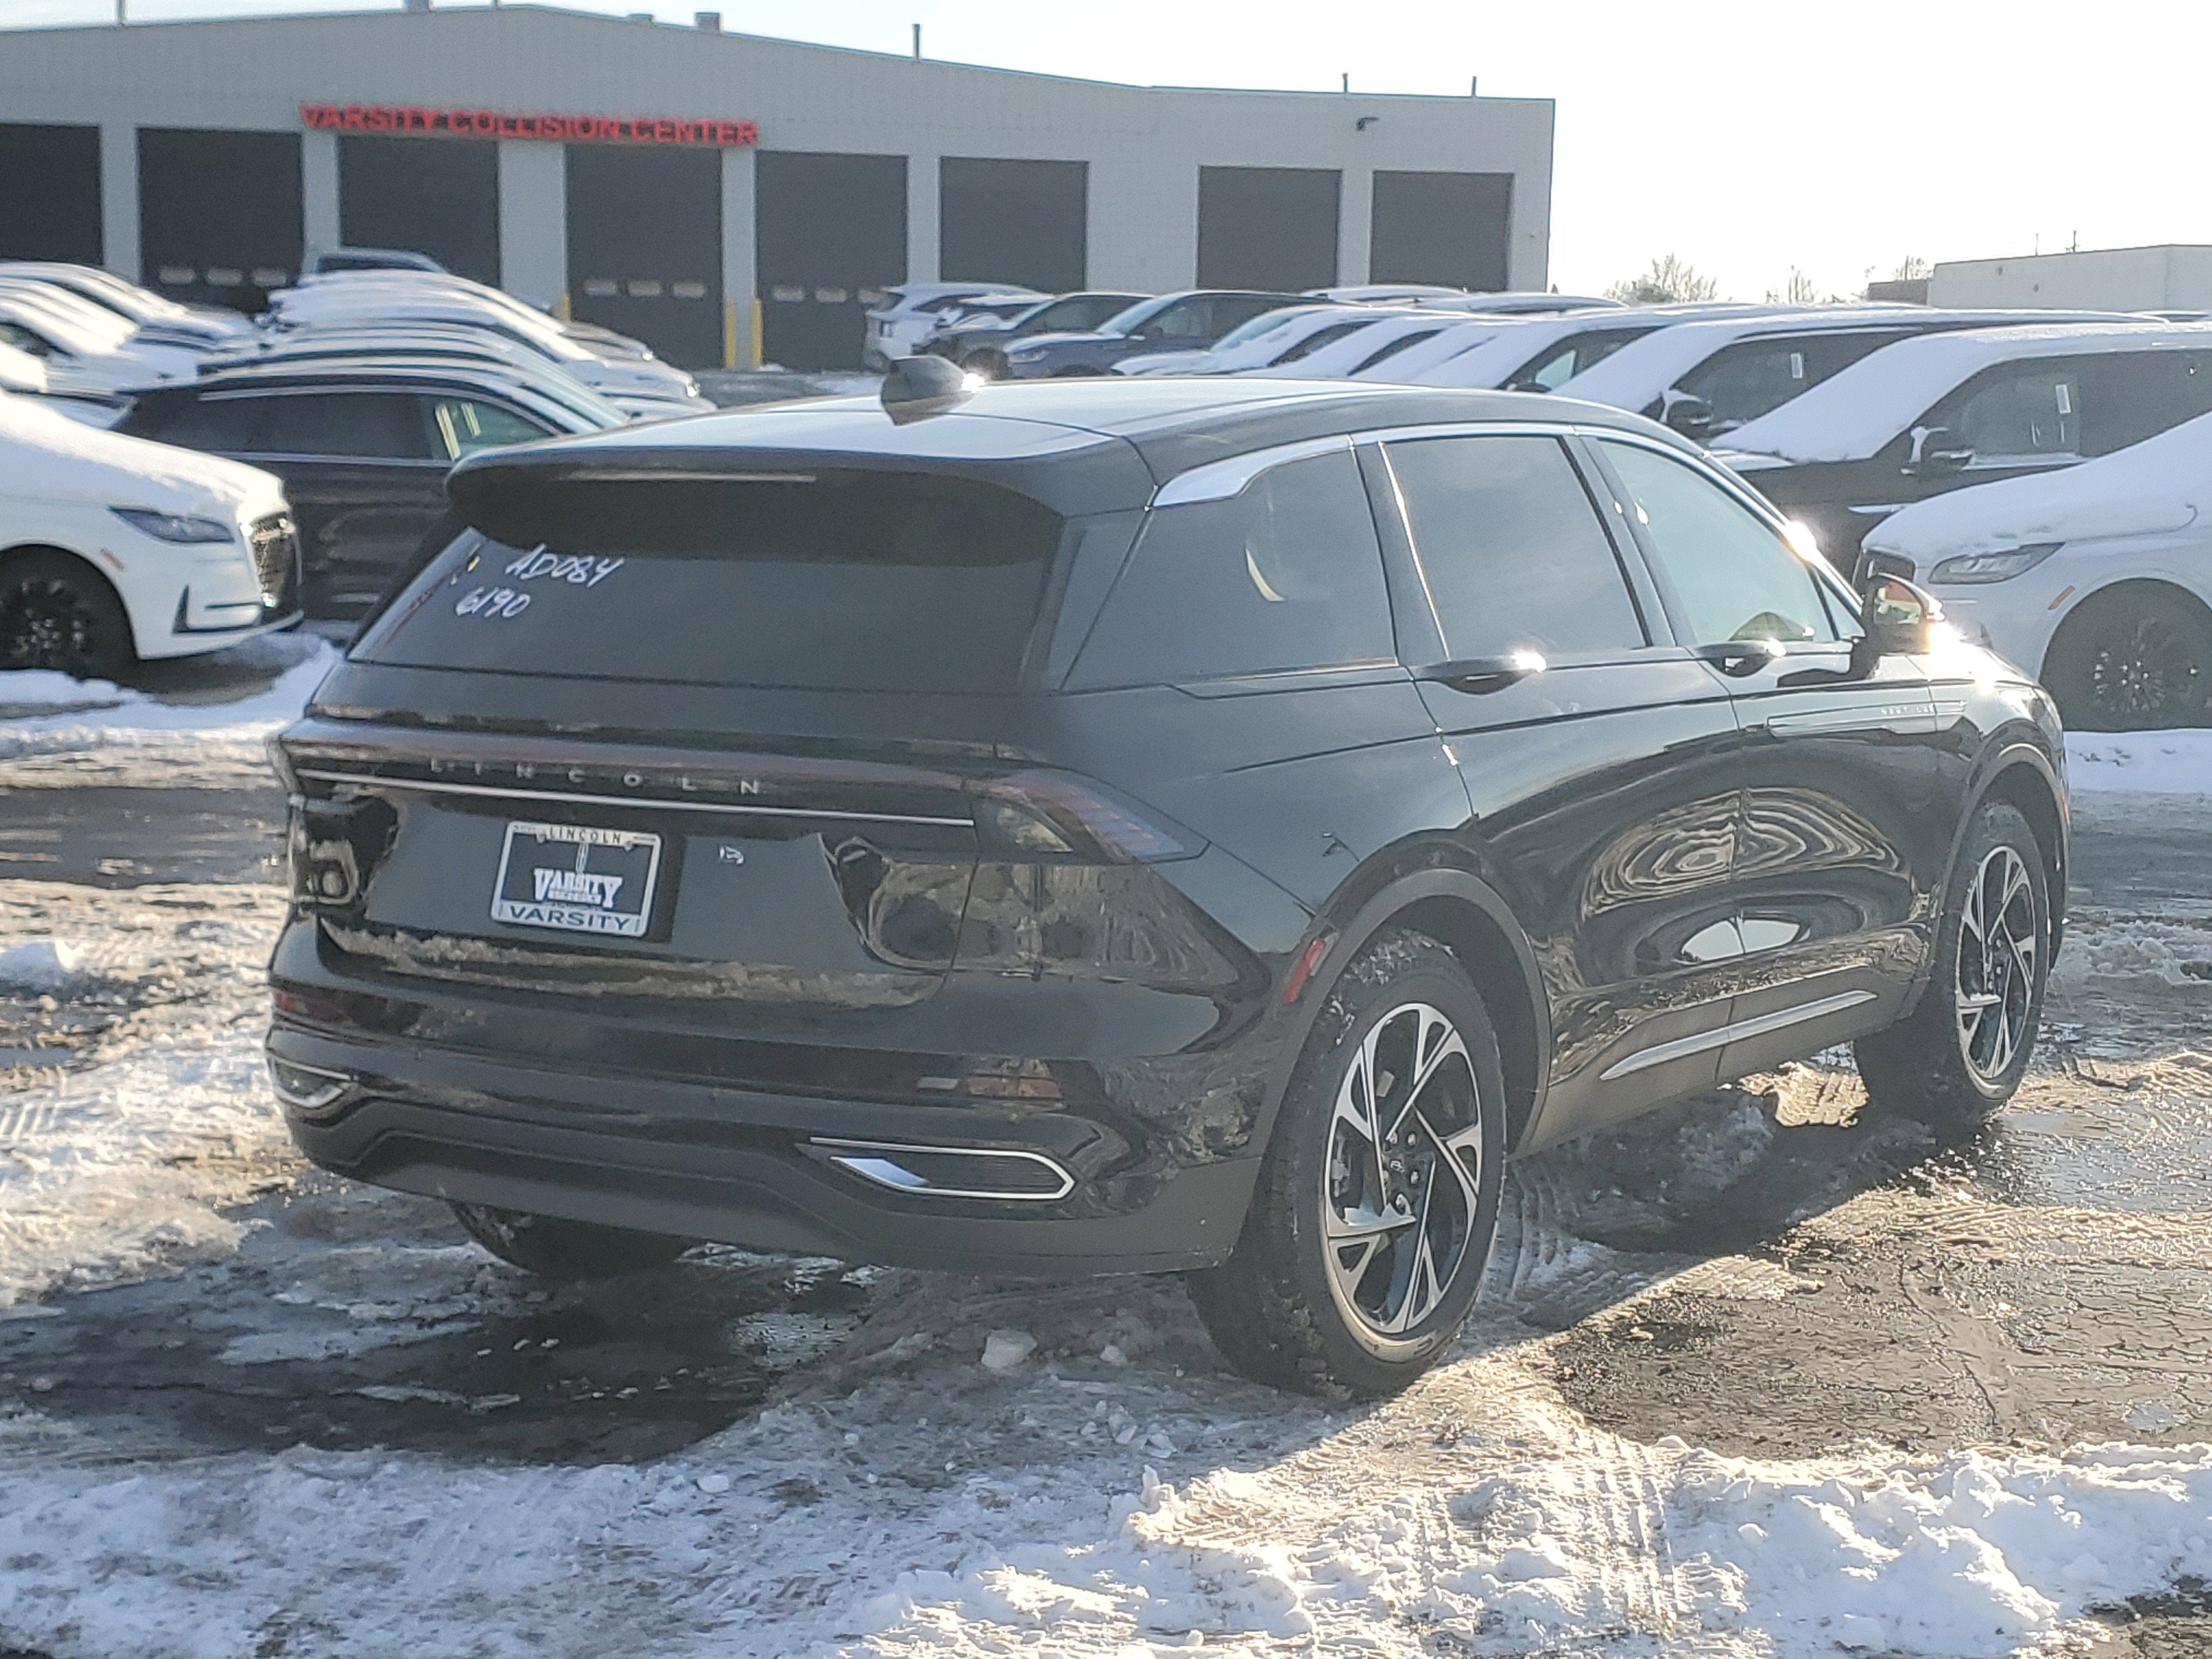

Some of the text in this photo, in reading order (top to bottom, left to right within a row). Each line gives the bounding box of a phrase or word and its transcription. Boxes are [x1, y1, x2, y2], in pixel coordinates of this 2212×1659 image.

[300, 100, 758, 146] VARSITY COLLISION CENTER
[430, 758, 759, 795] LINCOLN
[549, 826, 621, 844] LINCOLN
[510, 905, 630, 931] VARSITY
